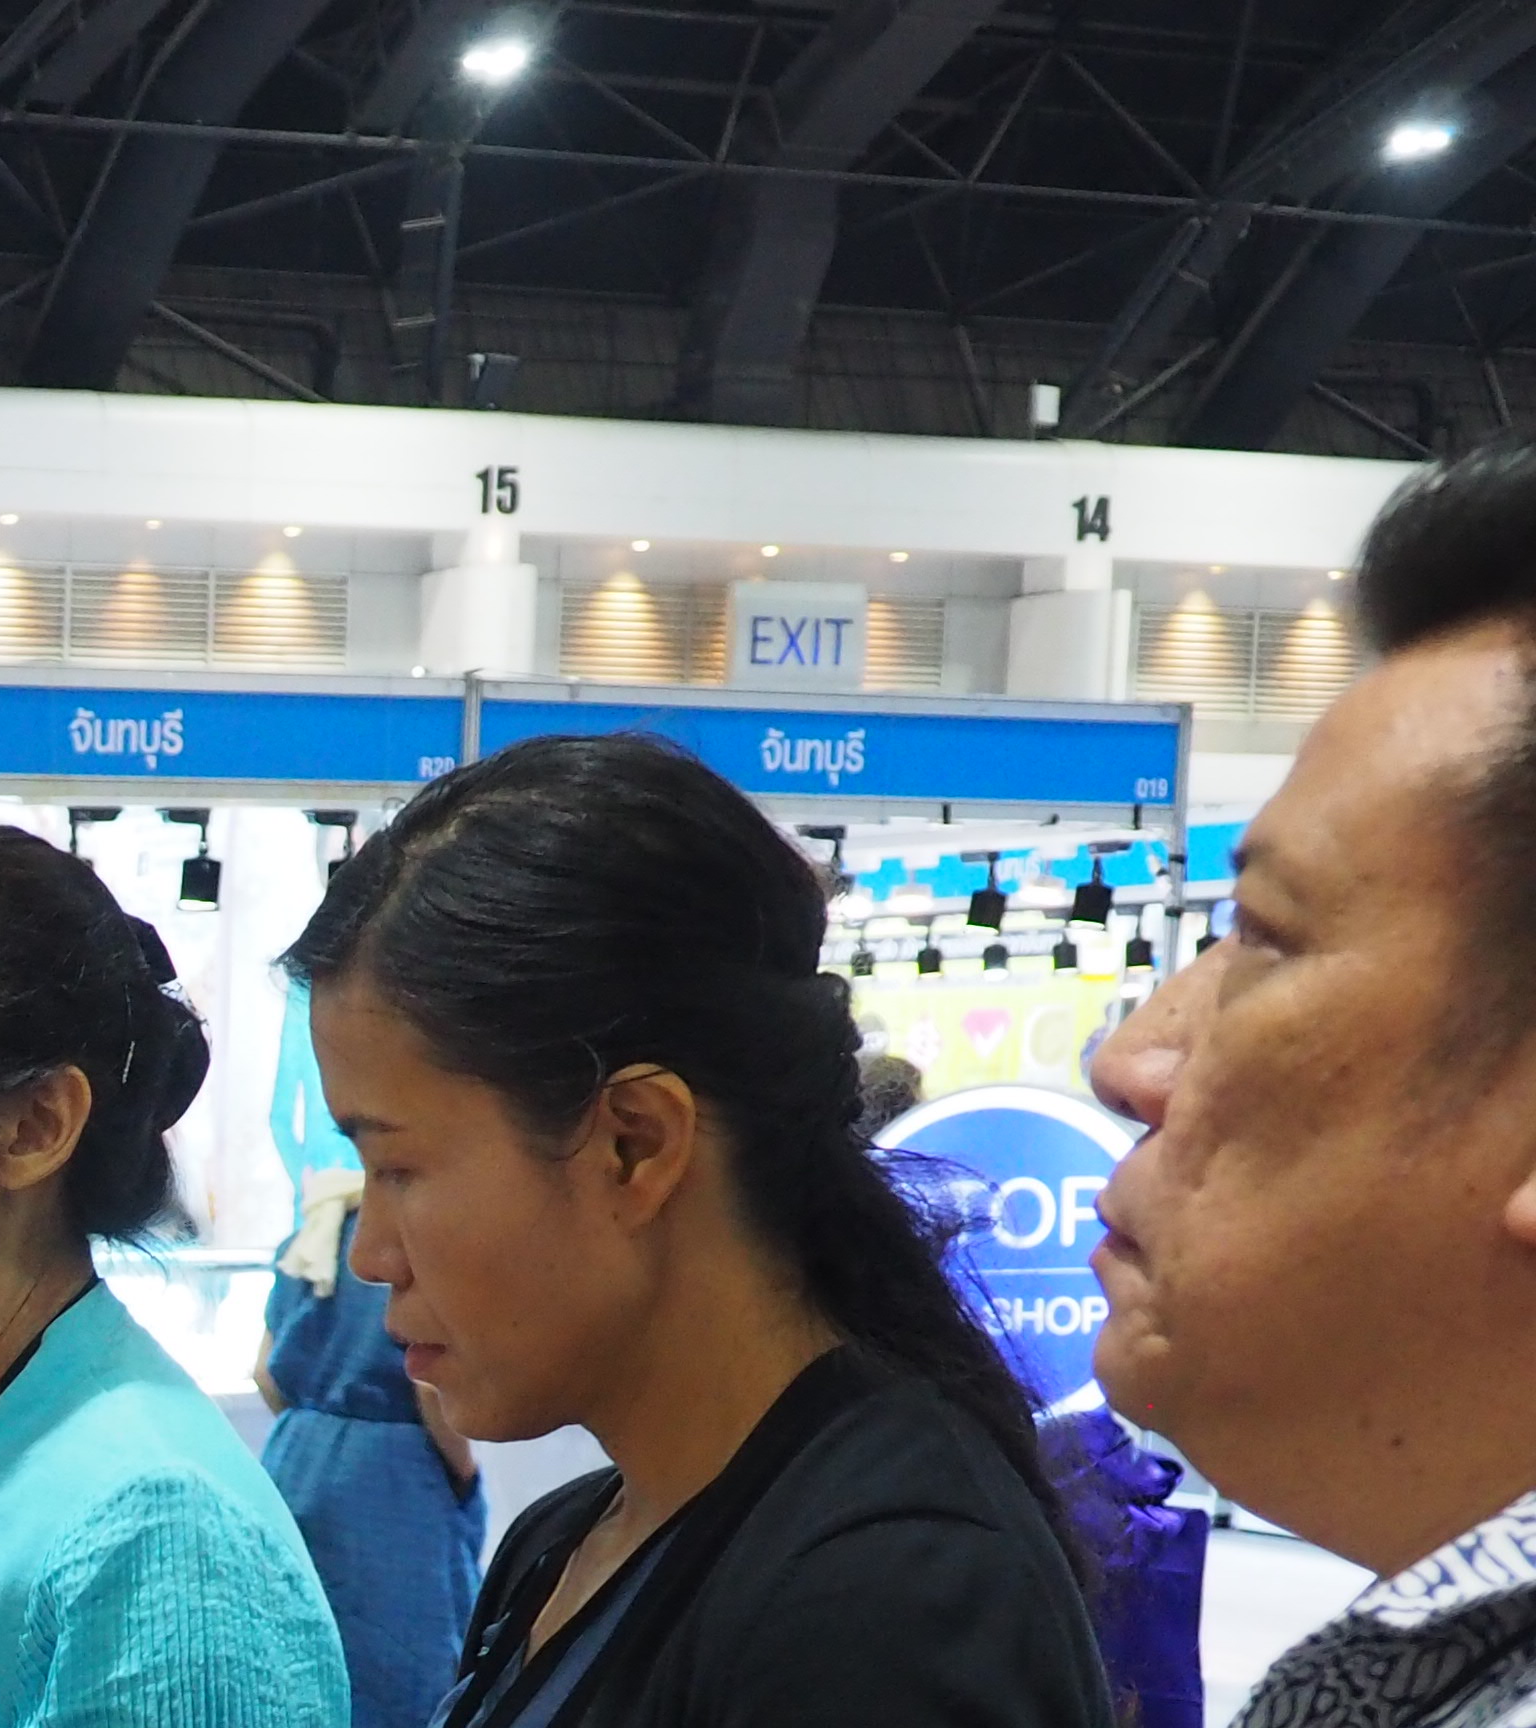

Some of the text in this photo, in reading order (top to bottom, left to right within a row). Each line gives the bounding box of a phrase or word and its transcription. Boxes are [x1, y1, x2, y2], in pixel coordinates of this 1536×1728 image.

[476, 466, 520, 515] 15
[1072, 494, 1111, 542] 14
[748, 615, 855, 668] EXIT
[68, 706, 185, 771] จันทบุรี
[760, 726, 866, 788] จันทบุรี
